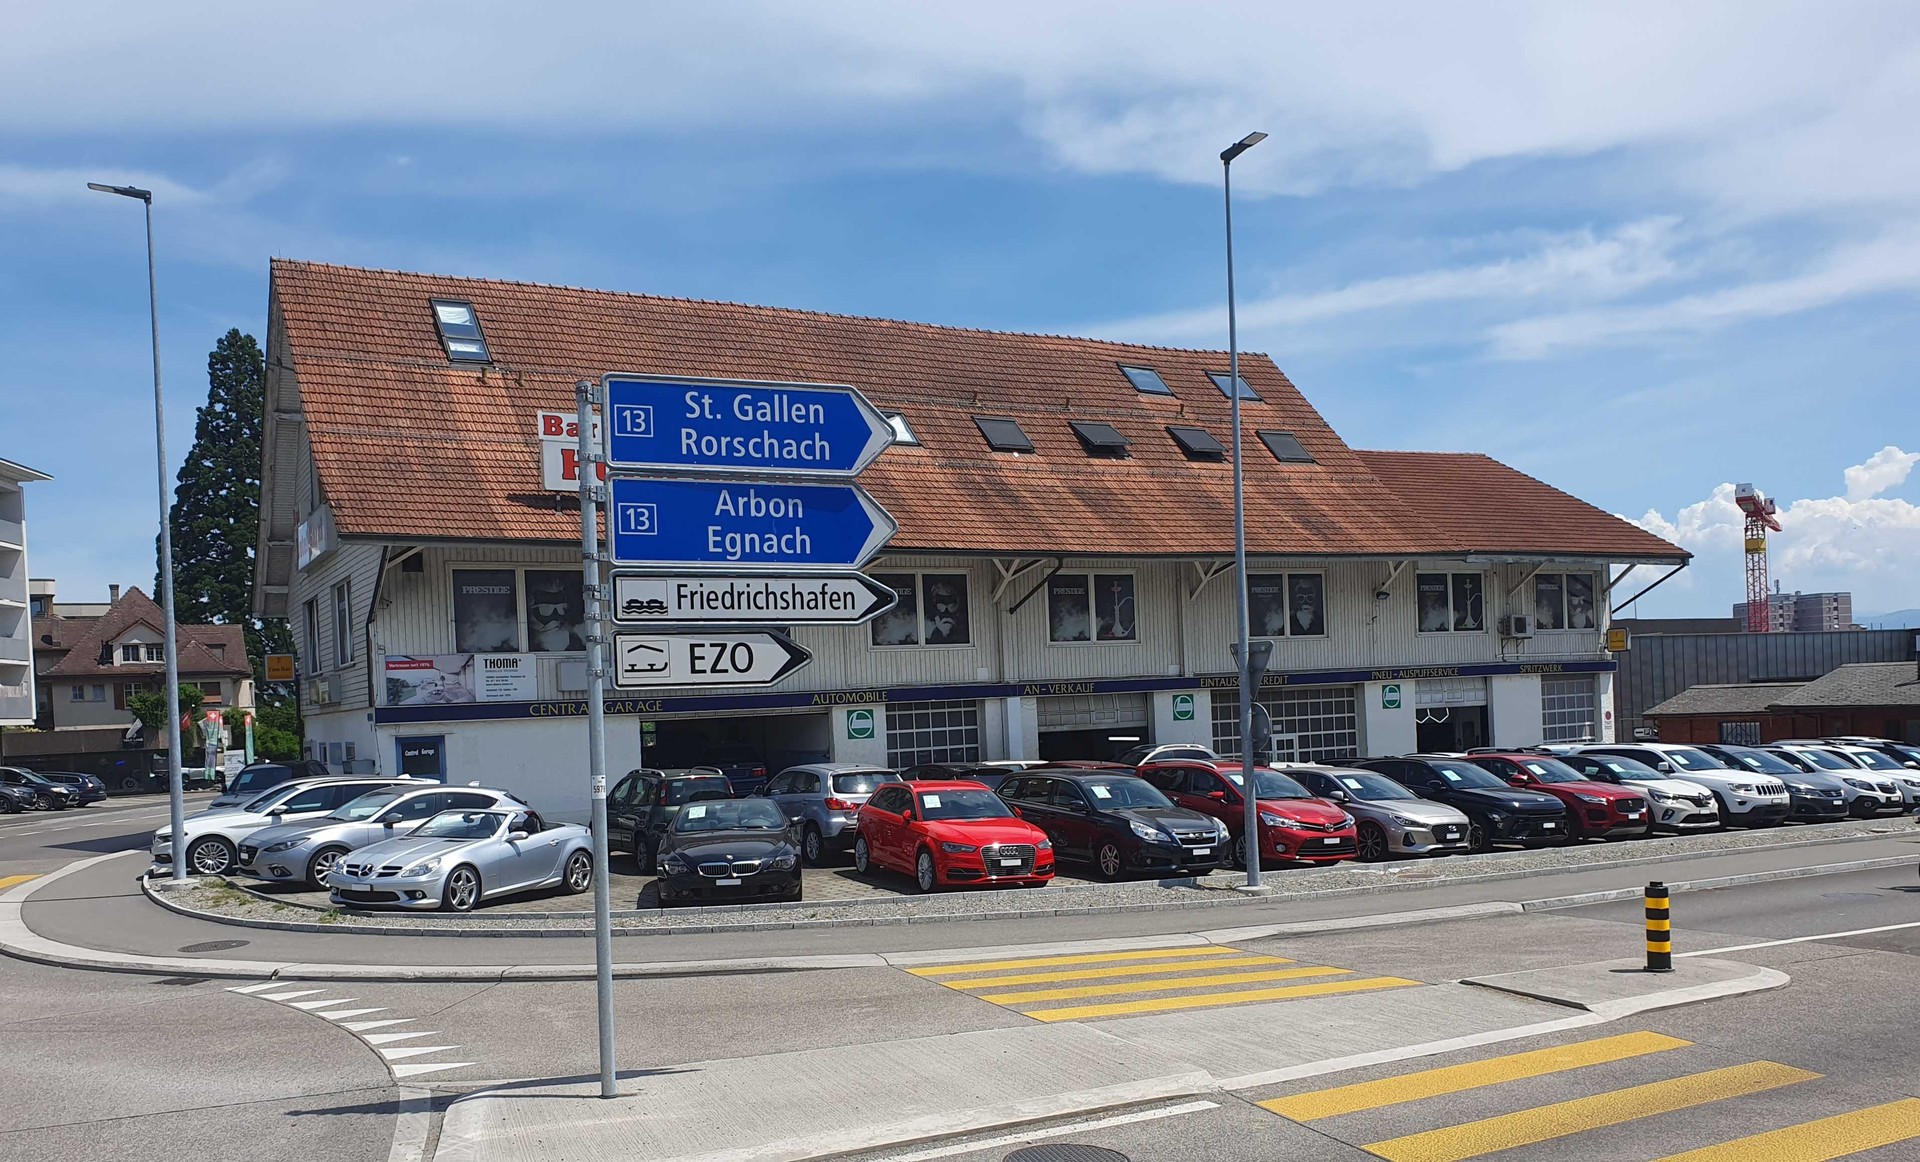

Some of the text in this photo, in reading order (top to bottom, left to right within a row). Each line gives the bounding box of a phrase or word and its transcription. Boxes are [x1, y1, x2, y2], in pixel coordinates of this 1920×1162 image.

[685, 391, 825, 424] St. Gallen
[622, 409, 647, 433] 13
[681, 428, 830, 461] Rorschach
[715, 489, 803, 518] Arbon
[626, 507, 650, 531] 13
[708, 526, 811, 561] Egnach
[462, 585, 510, 594] PRESTIGE
[676, 582, 856, 611] Friedrichshafen
[483, 657, 519, 669] THOMA
[689, 642, 754, 675] EZO
[529, 700, 663, 717] CENTRA GARAGE
[812, 691, 889, 705] AUTOMOBILE
